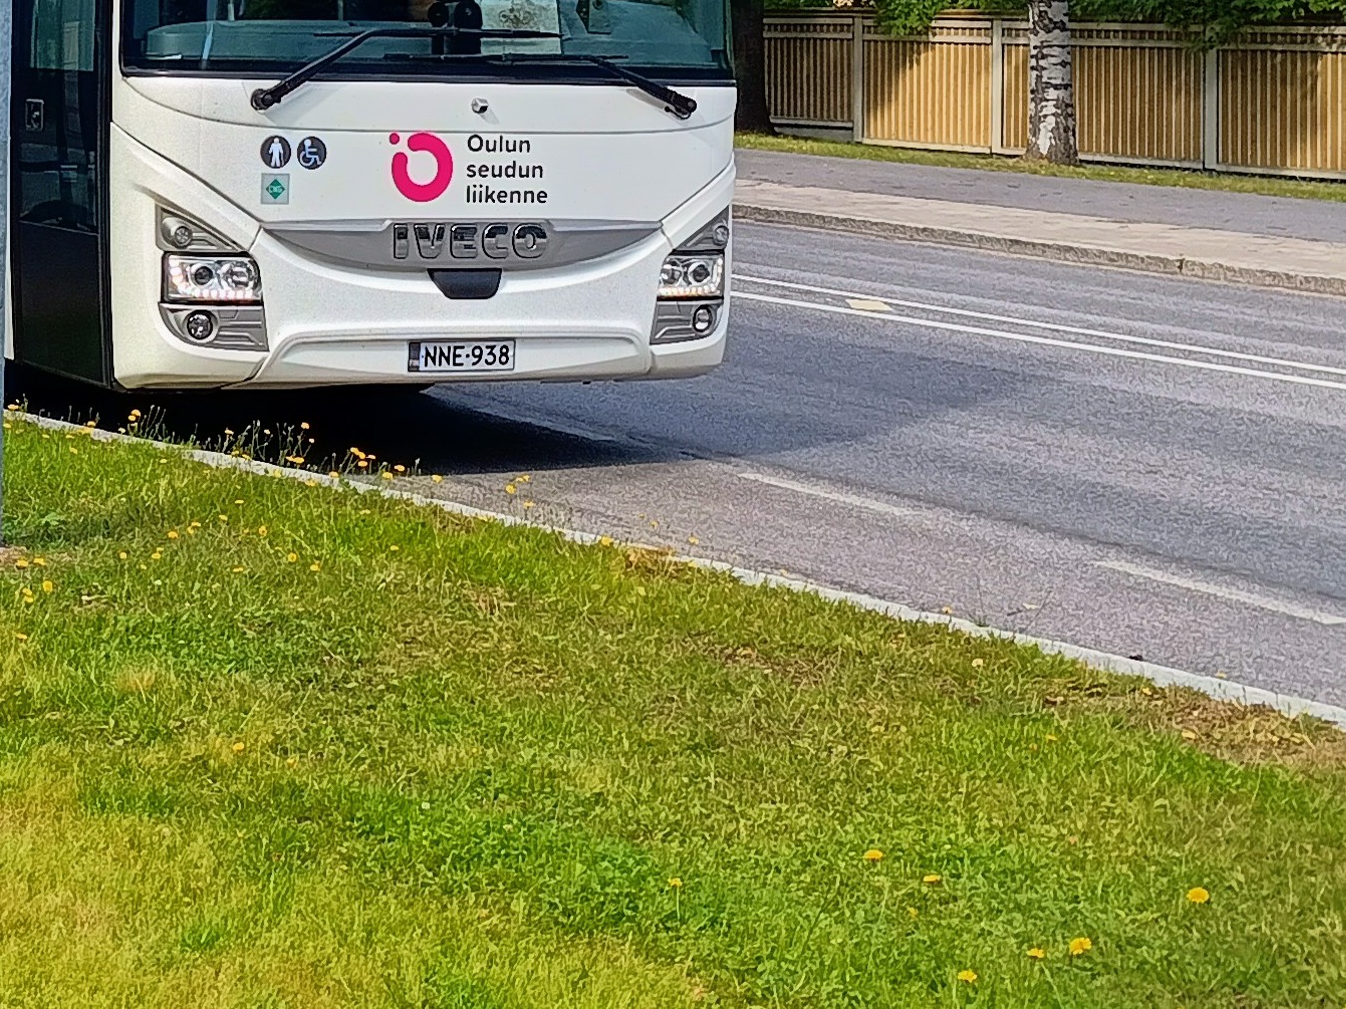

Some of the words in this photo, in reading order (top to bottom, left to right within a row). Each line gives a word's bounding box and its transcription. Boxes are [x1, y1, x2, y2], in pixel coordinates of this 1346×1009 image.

[466, 134, 531, 154] Oulun
[465, 161, 544, 179] seudun
[465, 184, 548, 204] liikenne
[392, 222, 548, 260] IVECO
[423, 344, 510, 368] NNE-938
